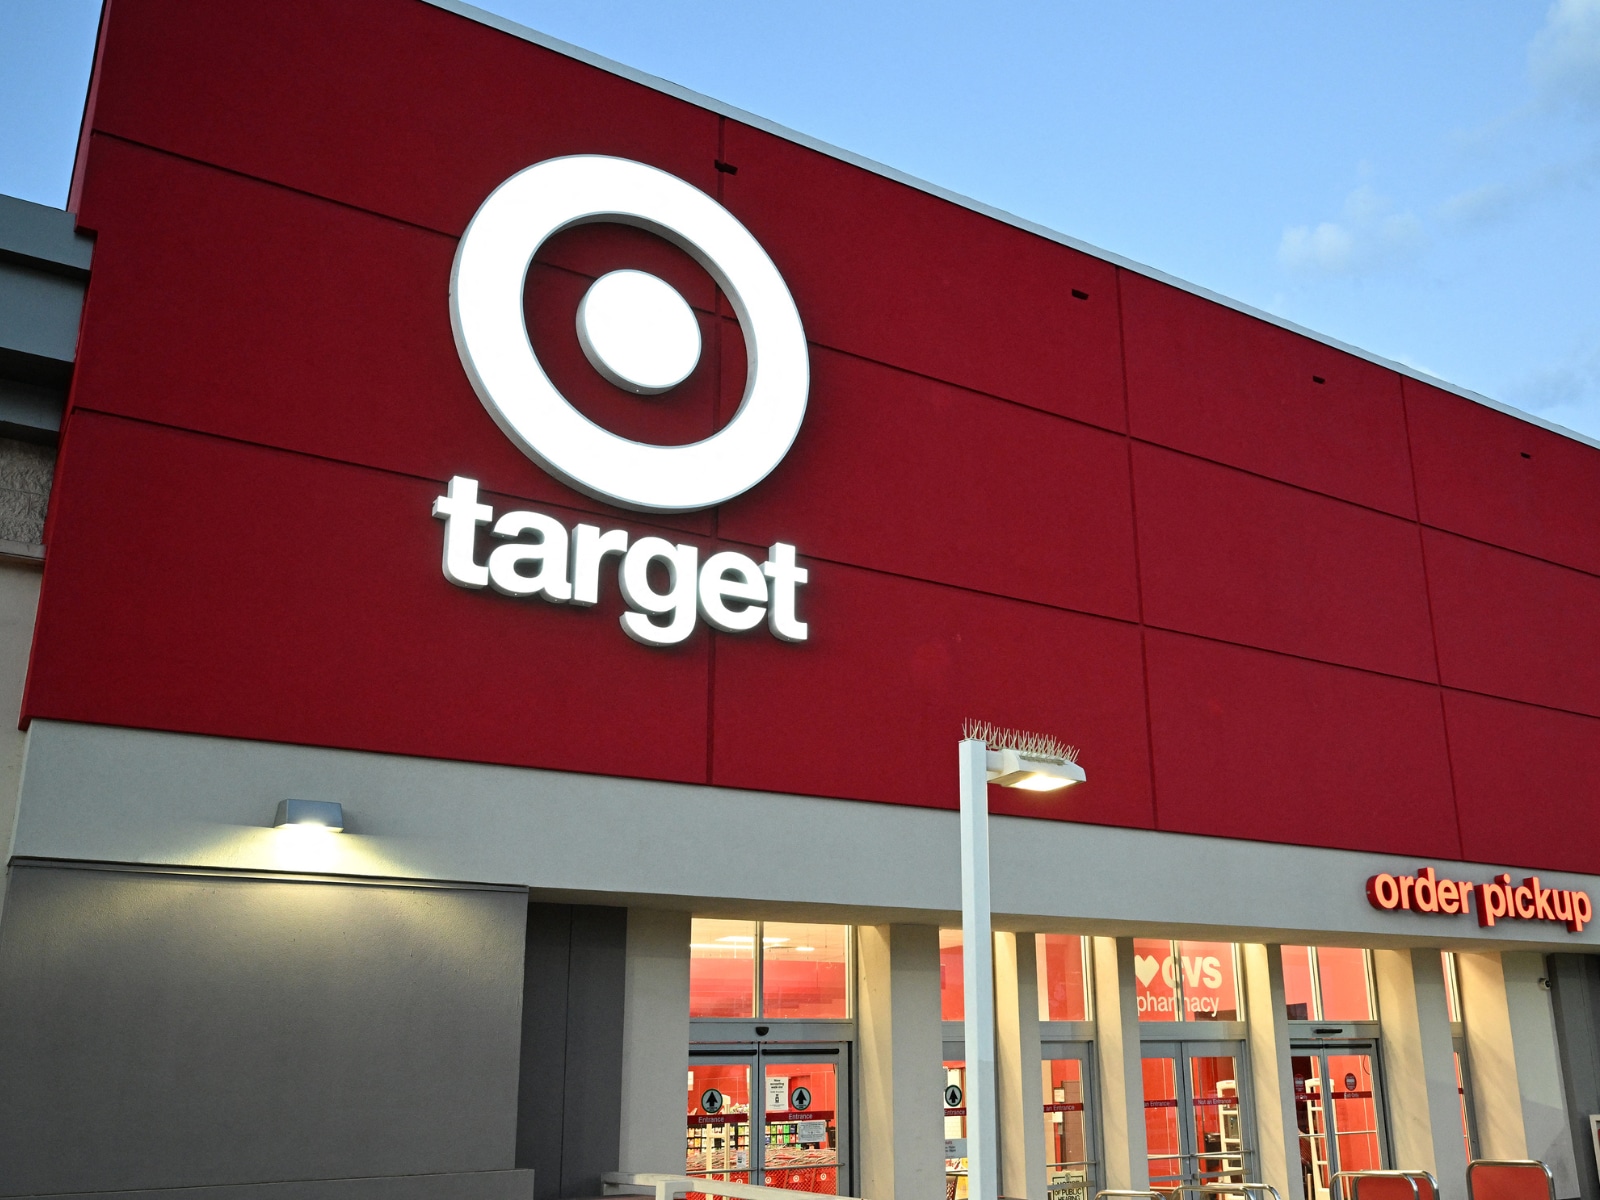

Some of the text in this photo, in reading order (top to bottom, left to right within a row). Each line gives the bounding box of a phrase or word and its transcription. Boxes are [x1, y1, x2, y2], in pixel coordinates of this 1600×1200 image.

[432, 475, 808, 647] target
[1367, 867, 1592, 932] order pickup
[1162, 956, 1222, 989] CVS
